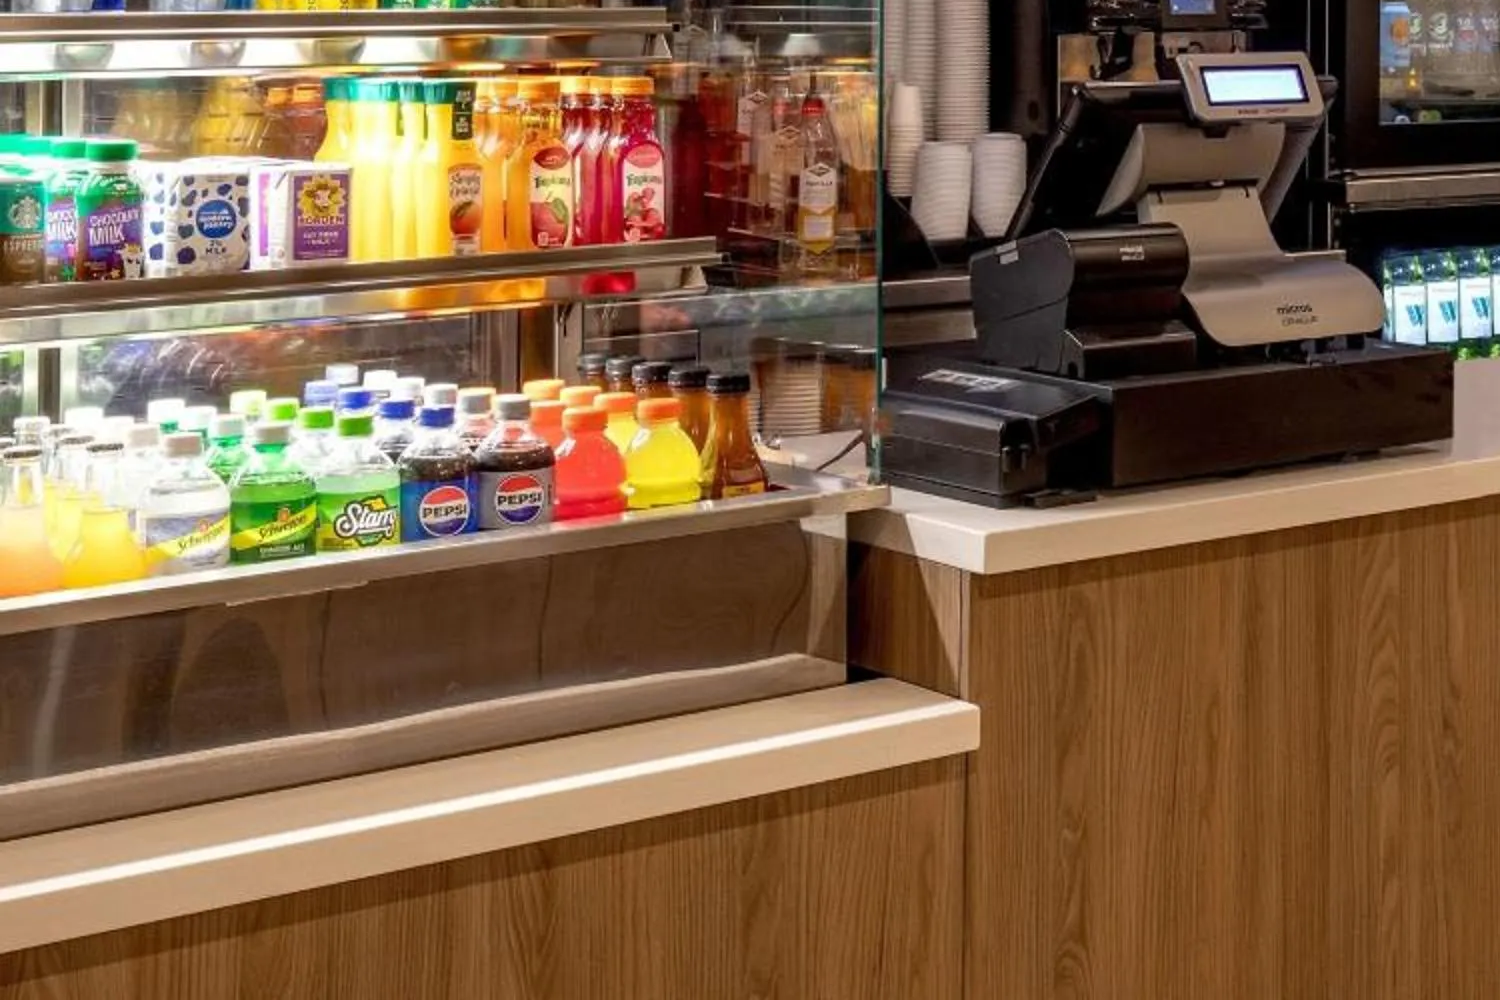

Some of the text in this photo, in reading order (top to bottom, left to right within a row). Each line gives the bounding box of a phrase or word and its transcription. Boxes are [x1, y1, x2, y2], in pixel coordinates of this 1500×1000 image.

[89, 222, 125, 247] MILK
[1277, 303, 1313, 315] micros
[498, 492, 541, 505] PEPSI
[422, 503, 467, 519] PEPSI
